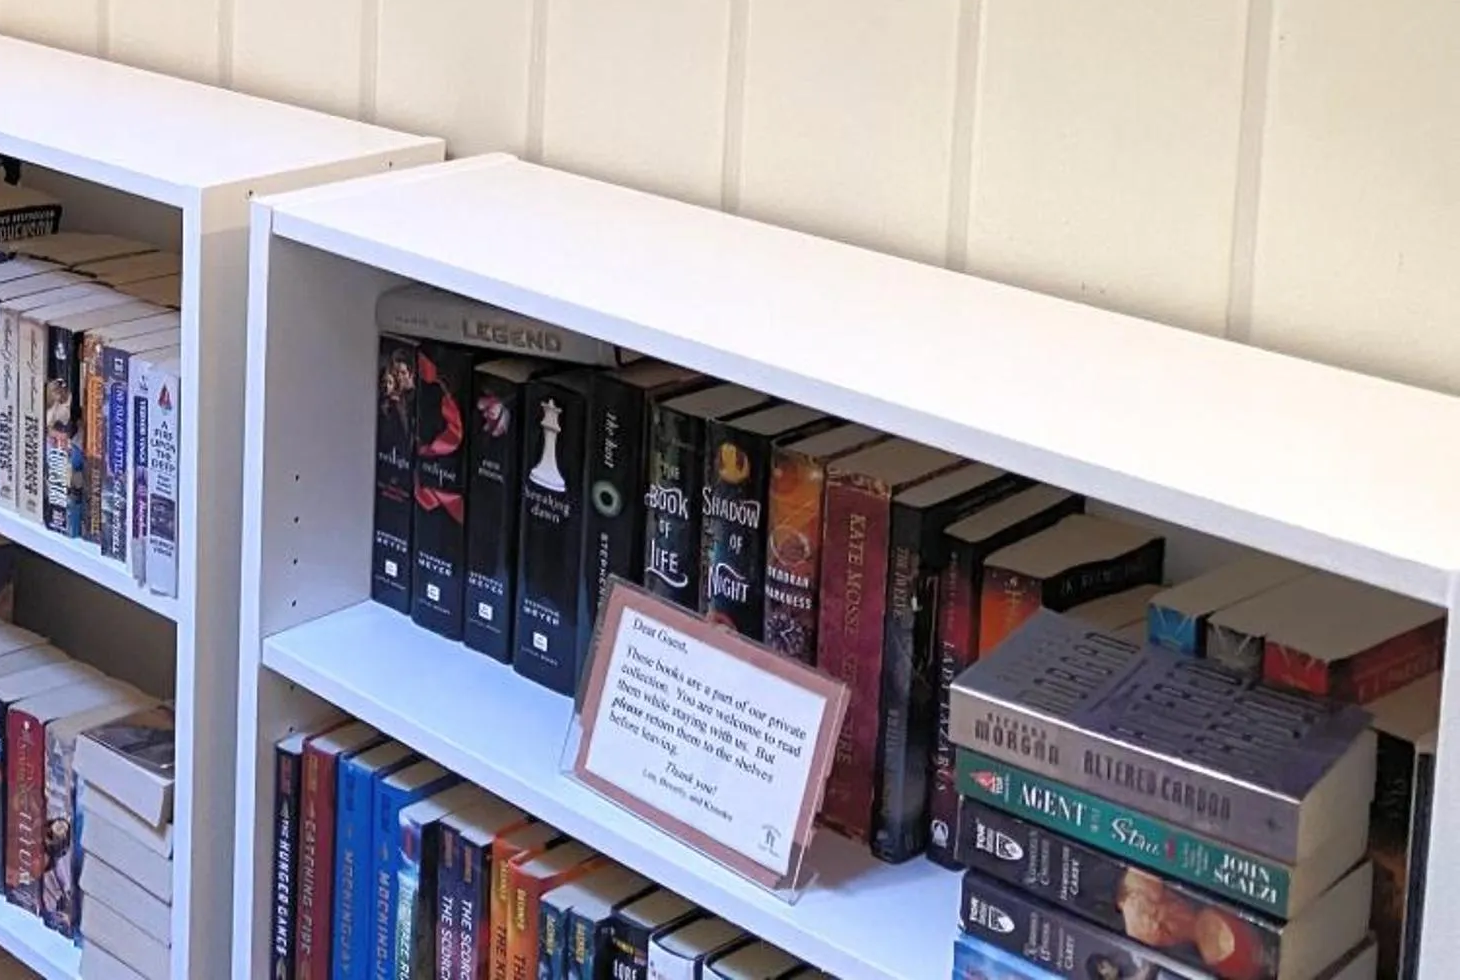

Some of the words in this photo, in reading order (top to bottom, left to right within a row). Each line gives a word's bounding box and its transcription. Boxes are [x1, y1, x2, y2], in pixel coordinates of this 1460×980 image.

[462, 319, 563, 353] LEGEND
[0, 413, 9, 470] CRISIS
[154, 427, 174, 443] FIRE
[161, 420, 168, 431] A
[24, 415, 34, 497] INCIDENT
[113, 439, 125, 477] BATTLE
[150, 437, 176, 454] UPON
[156, 448, 172, 463] THE
[603, 439, 618, 469] host
[151, 458, 176, 475] DEEP
[421, 461, 457, 487] eclipse
[661, 463, 680, 480] THE
[523, 485, 571, 517] breaking
[530, 504, 561, 524] dawn
[644, 484, 689, 521] BOOK
[702, 486, 761, 529] SHADOW
[376, 535, 408, 554] MEYER
[659, 520, 672, 539] OF
[728, 534, 743, 555] OF
[848, 513, 867, 570] KATE
[418, 557, 453, 578] MEYER
[644, 538, 689, 589] LIFE
[767, 563, 810, 589] DEBORAH
[468, 576, 505, 597] MEYER
[707, 562, 749, 603] NIGHT
[764, 583, 814, 611] HARKNESS
[523, 604, 561, 627] MEYER
[844, 570, 863, 639] MOSSE
[633, 617, 657, 638] Dear
[658, 628, 688, 654] Guest,
[627, 645, 655, 668] These
[656, 659, 685, 682] books
[686, 678, 702, 692] are
[704, 685, 711, 696] a
[711, 689, 733, 706] part
[735, 700, 750, 713] of
[748, 706, 768, 723] our
[768, 716, 808, 741] private
[609, 709, 640, 736] before
[611, 696, 644, 718] please
[645, 712, 676, 735] return
[676, 726, 702, 748] them
[703, 739, 715, 755] to
[715, 745, 733, 763] the
[733, 755, 774, 785] shelves
[617, 678, 641, 700] them
[643, 692, 671, 713] while
[671, 706, 708, 735] staying
[709, 725, 733, 745] with
[754, 745, 776, 766] But
[676, 686, 696, 708] You
[696, 700, 714, 716] are
[715, 708, 762, 740] welcome
[764, 731, 776, 746] to
[777, 738, 803, 759] read
[936, 702, 952, 794] LAZARUS
[974, 718, 1062, 766] MORGAN
[665, 760, 694, 785] Thank
[693, 777, 718, 797] you!
[1083, 748, 1158, 797] ALTERED
[1161, 775, 1232, 821] CARBON
[1019, 783, 1087, 827] AGENT
[976, 822, 987, 850] TOR
[276, 840, 290, 905] HUNGER
[301, 819, 317, 908] CATCHING
[1069, 858, 1082, 896] CAREY
[1223, 853, 1271, 885] JOHN
[1213, 867, 1279, 905] SCALZI
[341, 849, 355, 974] MOCKINGJAY
[441, 895, 453, 927] THE
[460, 899, 472, 931] THE
[274, 905, 289, 957] GAMES
[300, 913, 313, 956] FIRE
[496, 924, 507, 958] THE
[1063, 933, 1075, 971] CAREY
